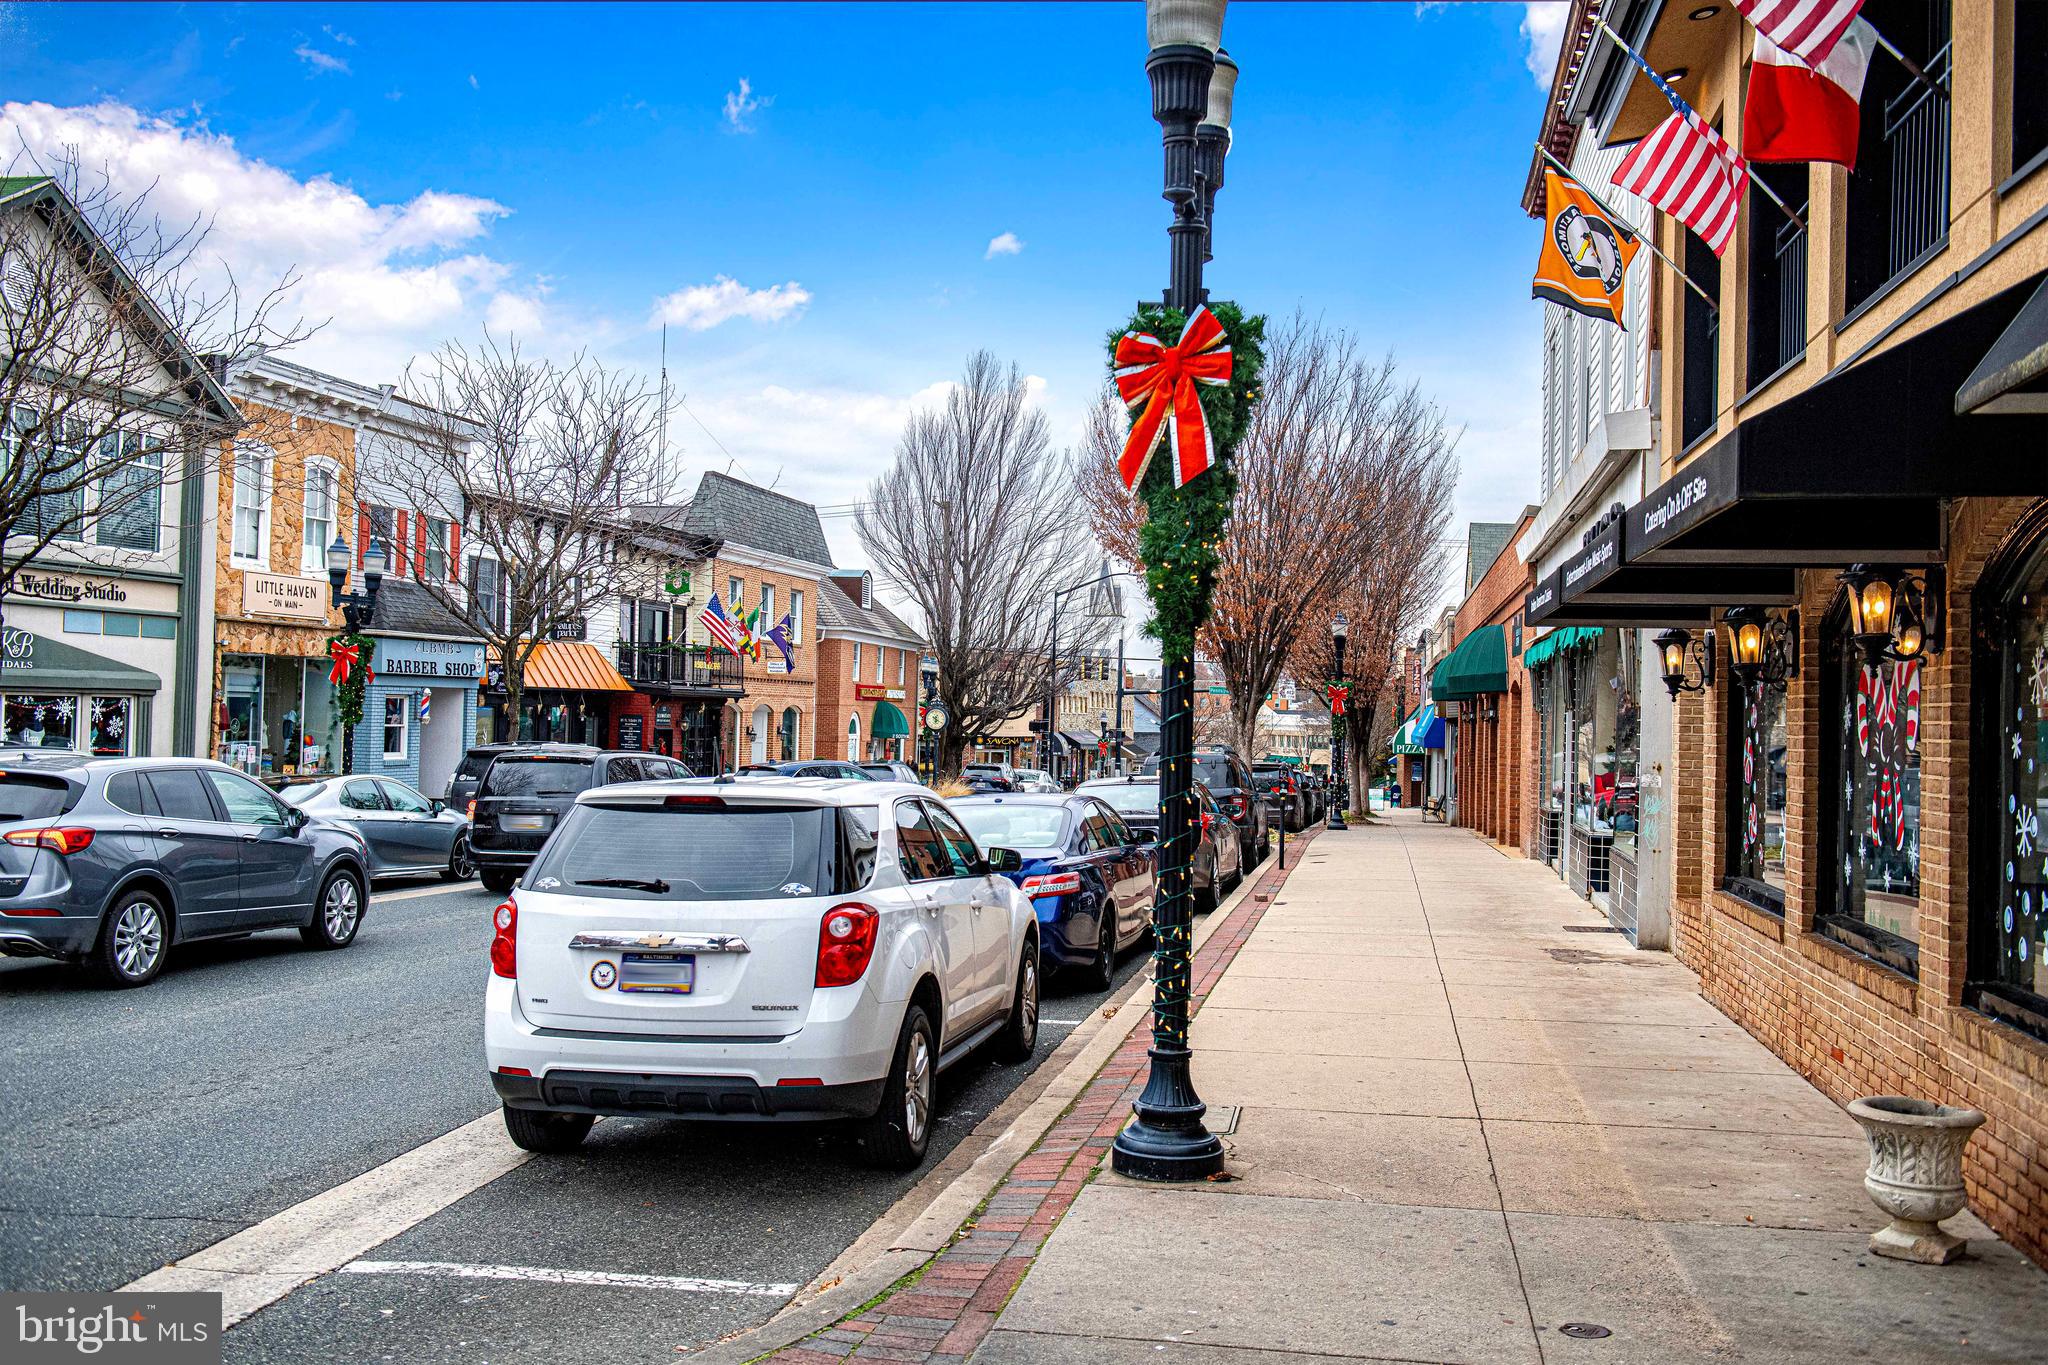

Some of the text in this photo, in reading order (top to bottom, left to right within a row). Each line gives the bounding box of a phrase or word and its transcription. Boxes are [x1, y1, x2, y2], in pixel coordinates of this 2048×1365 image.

[1666, 496, 1675, 520] On
[1675, 492, 1681, 515] &
[1692, 476, 1707, 503] Site
[20, 574, 81, 602] Wedding
[84, 581, 127, 602] Studio
[256, 580, 317, 599] LITTLE HAVEN
[273, 599, 298, 609] ON MAIN
[386, 659, 476, 677] BARBER SHOP
[986, 736, 1020, 745] SAVONA
[1396, 744, 1425, 754] PIZZA
